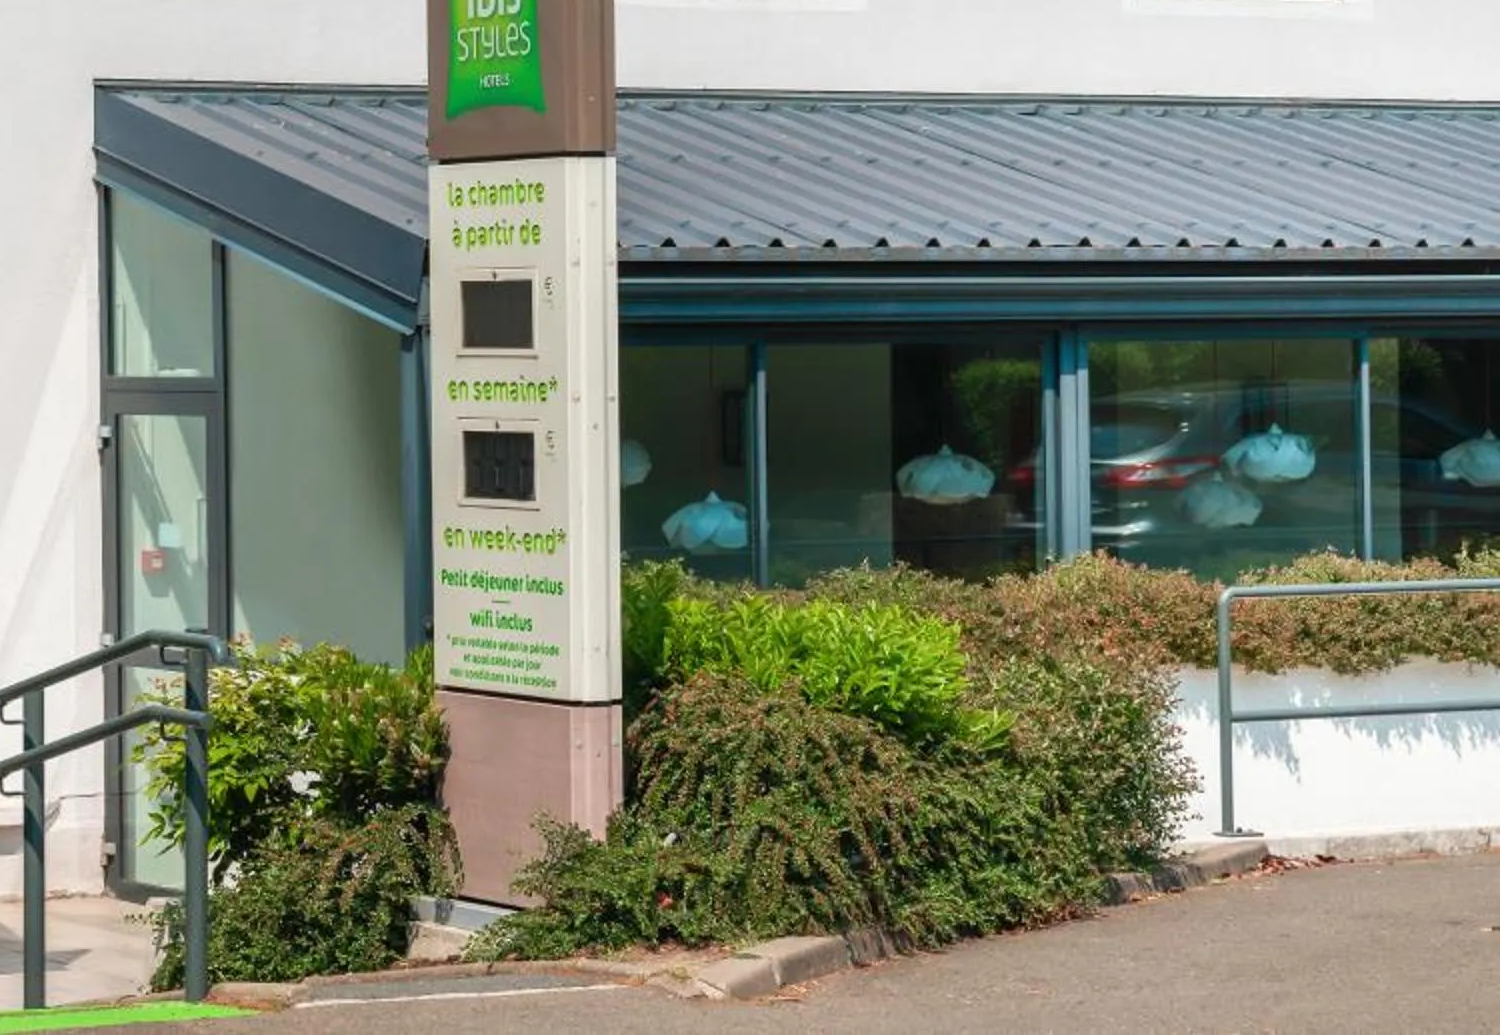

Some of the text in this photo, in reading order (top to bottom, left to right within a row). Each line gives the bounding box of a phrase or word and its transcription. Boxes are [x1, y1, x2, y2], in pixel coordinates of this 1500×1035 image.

[479, 72, 511, 89] HOTELS
[447, 178, 545, 207] la chambre
[452, 218, 542, 252] à partir de
[447, 380, 469, 401] en
[443, 526, 465, 549] en
[441, 569, 564, 596] Petit déjeuner inclus
[469, 609, 533, 632] wifi inclus
